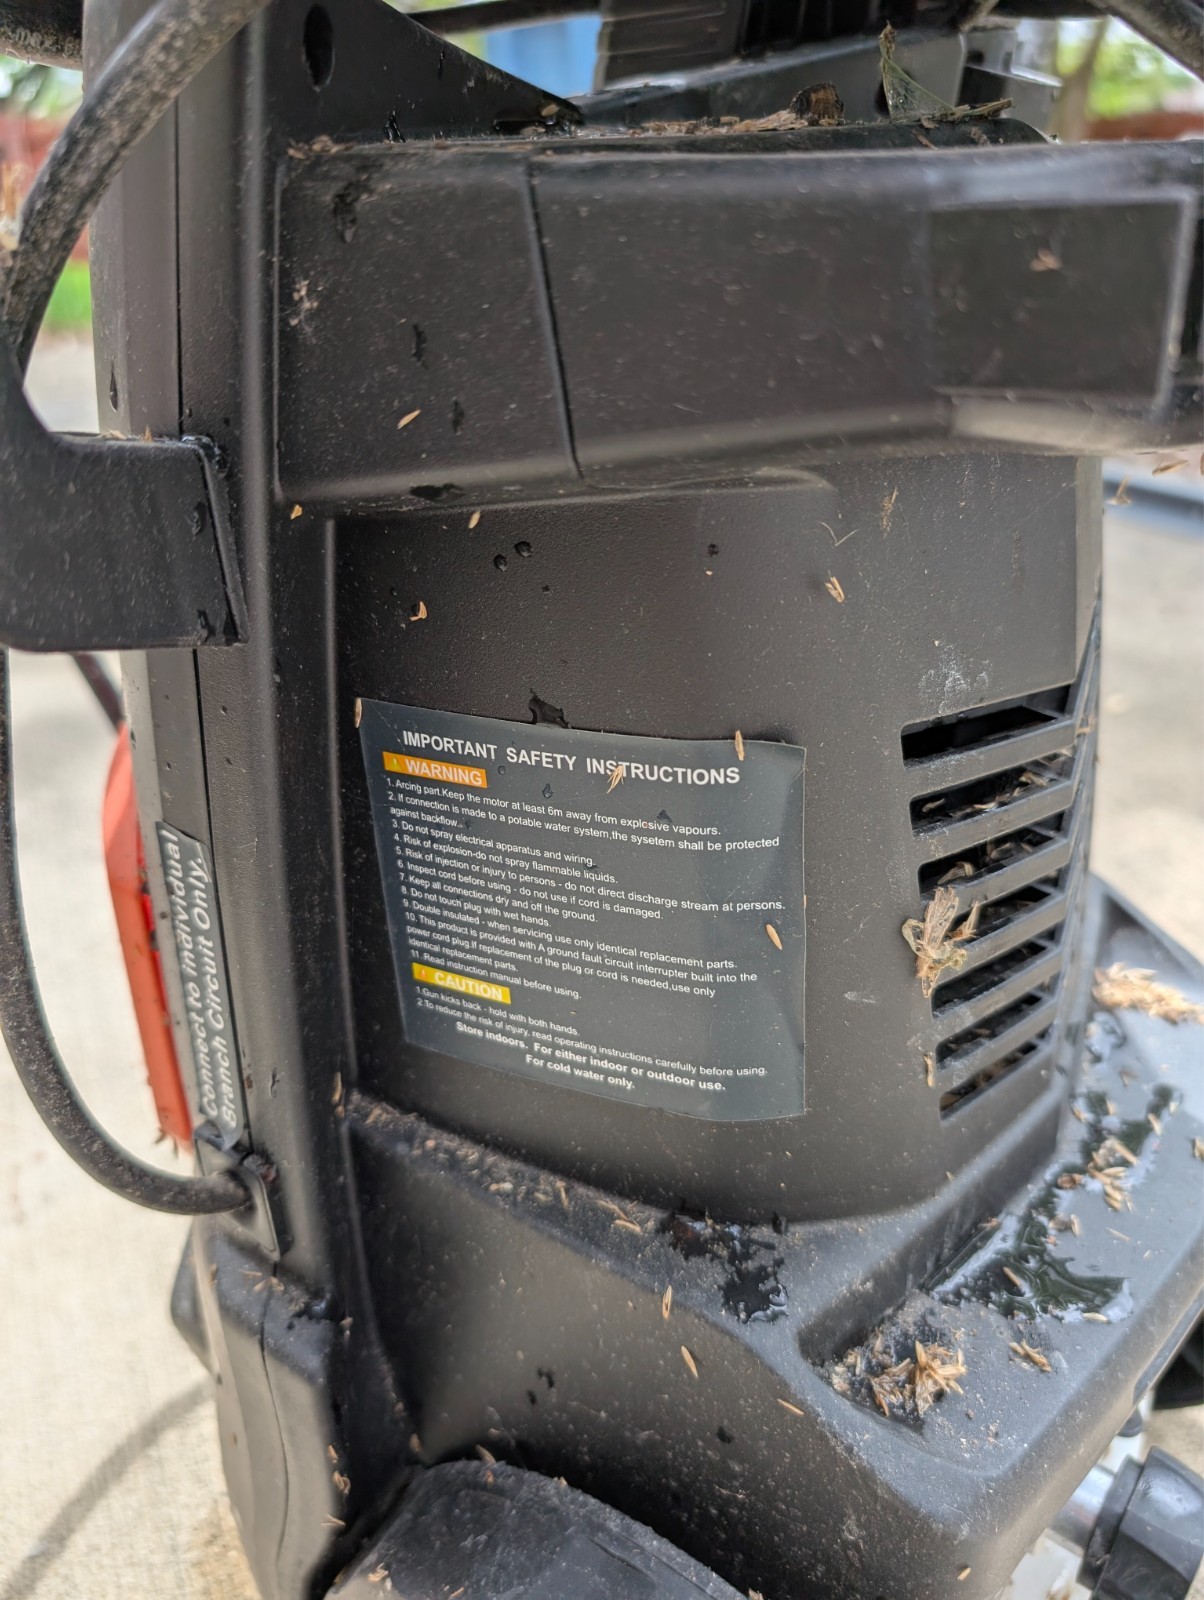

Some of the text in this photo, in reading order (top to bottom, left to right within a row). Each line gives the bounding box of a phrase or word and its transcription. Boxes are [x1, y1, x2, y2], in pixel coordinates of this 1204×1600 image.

[403, 730, 739, 784] IMPORTANT SAFETY INSTRUCTIONS
[405, 759, 481, 786] WARNING
[390, 807, 419, 819] against
[395, 779, 421, 794] Arcing
[466, 793, 480, 803] the
[482, 797, 509, 807] motor
[511, 802, 520, 810] at
[522, 802, 545, 814] least
[547, 806, 562, 816] 6m
[565, 811, 591, 823] away
[594, 812, 617, 824] from
[620, 818, 669, 831] explosive
[672, 825, 720, 835] vapours.
[405, 796, 450, 811] connection
[461, 807, 486, 818] made
[507, 816, 541, 828] potable
[544, 822, 570, 832] water
[630, 834, 674, 847] sysetem
[678, 839, 703, 850] shall
[707, 841, 721, 850] be
[725, 836, 779, 852] protected
[401, 820, 595, 867] Do not spray electrical apparatus and wiring.
[403, 834, 617, 883] Risk explosion-do not spray flammable liquids.
[405, 848, 785, 912] Risk injection injury persons do not direct discharge stream at persons.
[407, 861, 663, 918] Inspect cord before using do not use cord damaged.
[408, 875, 430, 889] Keep
[442, 884, 493, 901] connections
[495, 895, 509, 906] dry
[511, 899, 528, 908] and
[544, 905, 559, 915] the
[561, 909, 597, 921] ground.
[410, 887, 551, 926] Do not touch plug with wet hands.
[406, 925, 430, 937] power
[432, 932, 450, 942] cord
[478, 944, 531, 962] replacement
[544, 958, 559, 968] the
[561, 962, 581, 974] plug
[596, 969, 617, 979] cord
[693, 987, 715, 998] only
[408, 938, 519, 971] identical replacement parts.
[412, 900, 737, 969] Double insulated when servicing use only identical replacement parts.
[418, 914, 757, 982] This product provided with ground fault circuit interrupter built into the
[159, 829, 218, 1118] Connect to individual
[187, 857, 236, 1129] Branch Circuit Only.
[423, 952, 581, 999] Read instruction manual before using.
[434, 972, 502, 1001] CAUTION
[436, 1003, 462, 1016] reduce
[463, 1012, 476, 1021] the
[478, 1017, 493, 1025] risk
[532, 1031, 552, 1041] read
[554, 1036, 596, 1053] operating
[598, 1047, 652, 1063] instructions
[655, 1059, 696, 1074] carefully
[699, 1065, 733, 1075] before
[736, 1067, 767, 1076] using.
[462, 999, 481, 1010] back
[488, 1006, 507, 1017] hold
[508, 1013, 526, 1022] with
[528, 1016, 547, 1027] both
[549, 1021, 580, 1035] hands.
[456, 1021, 725, 1090] Store indoors. For either indoor or outdoor use.
[526, 1054, 635, 1090] For cold water only.
